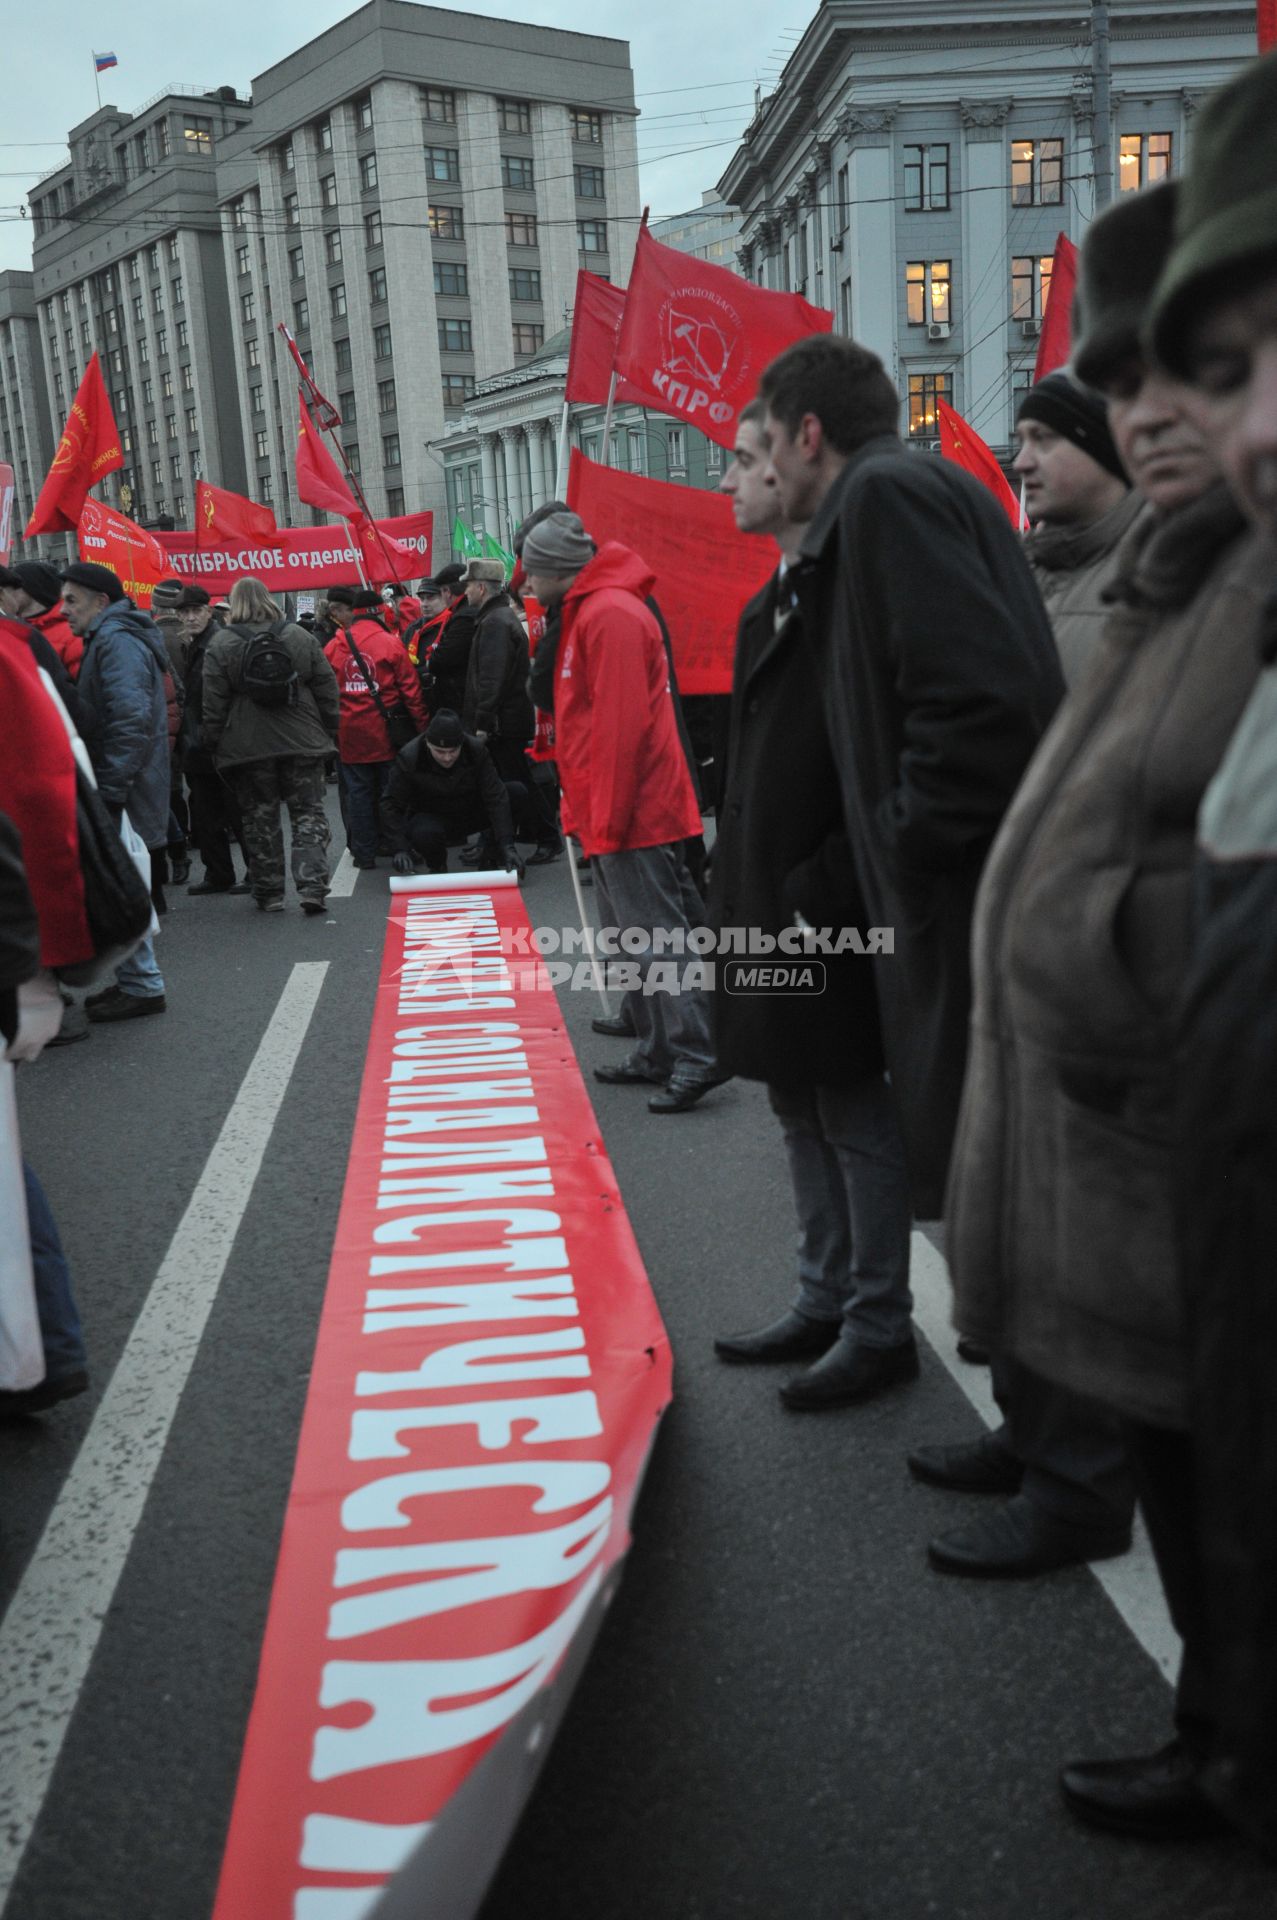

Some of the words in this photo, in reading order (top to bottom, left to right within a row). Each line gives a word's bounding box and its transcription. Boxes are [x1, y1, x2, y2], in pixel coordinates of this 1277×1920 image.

[652, 368, 734, 423] КПРФ
[169, 548, 284, 573] КТЯБРЬСКОЕ
[288, 548, 364, 568] отделен
[397, 894, 516, 1016] ОКТЯБРЬСКАЯ
